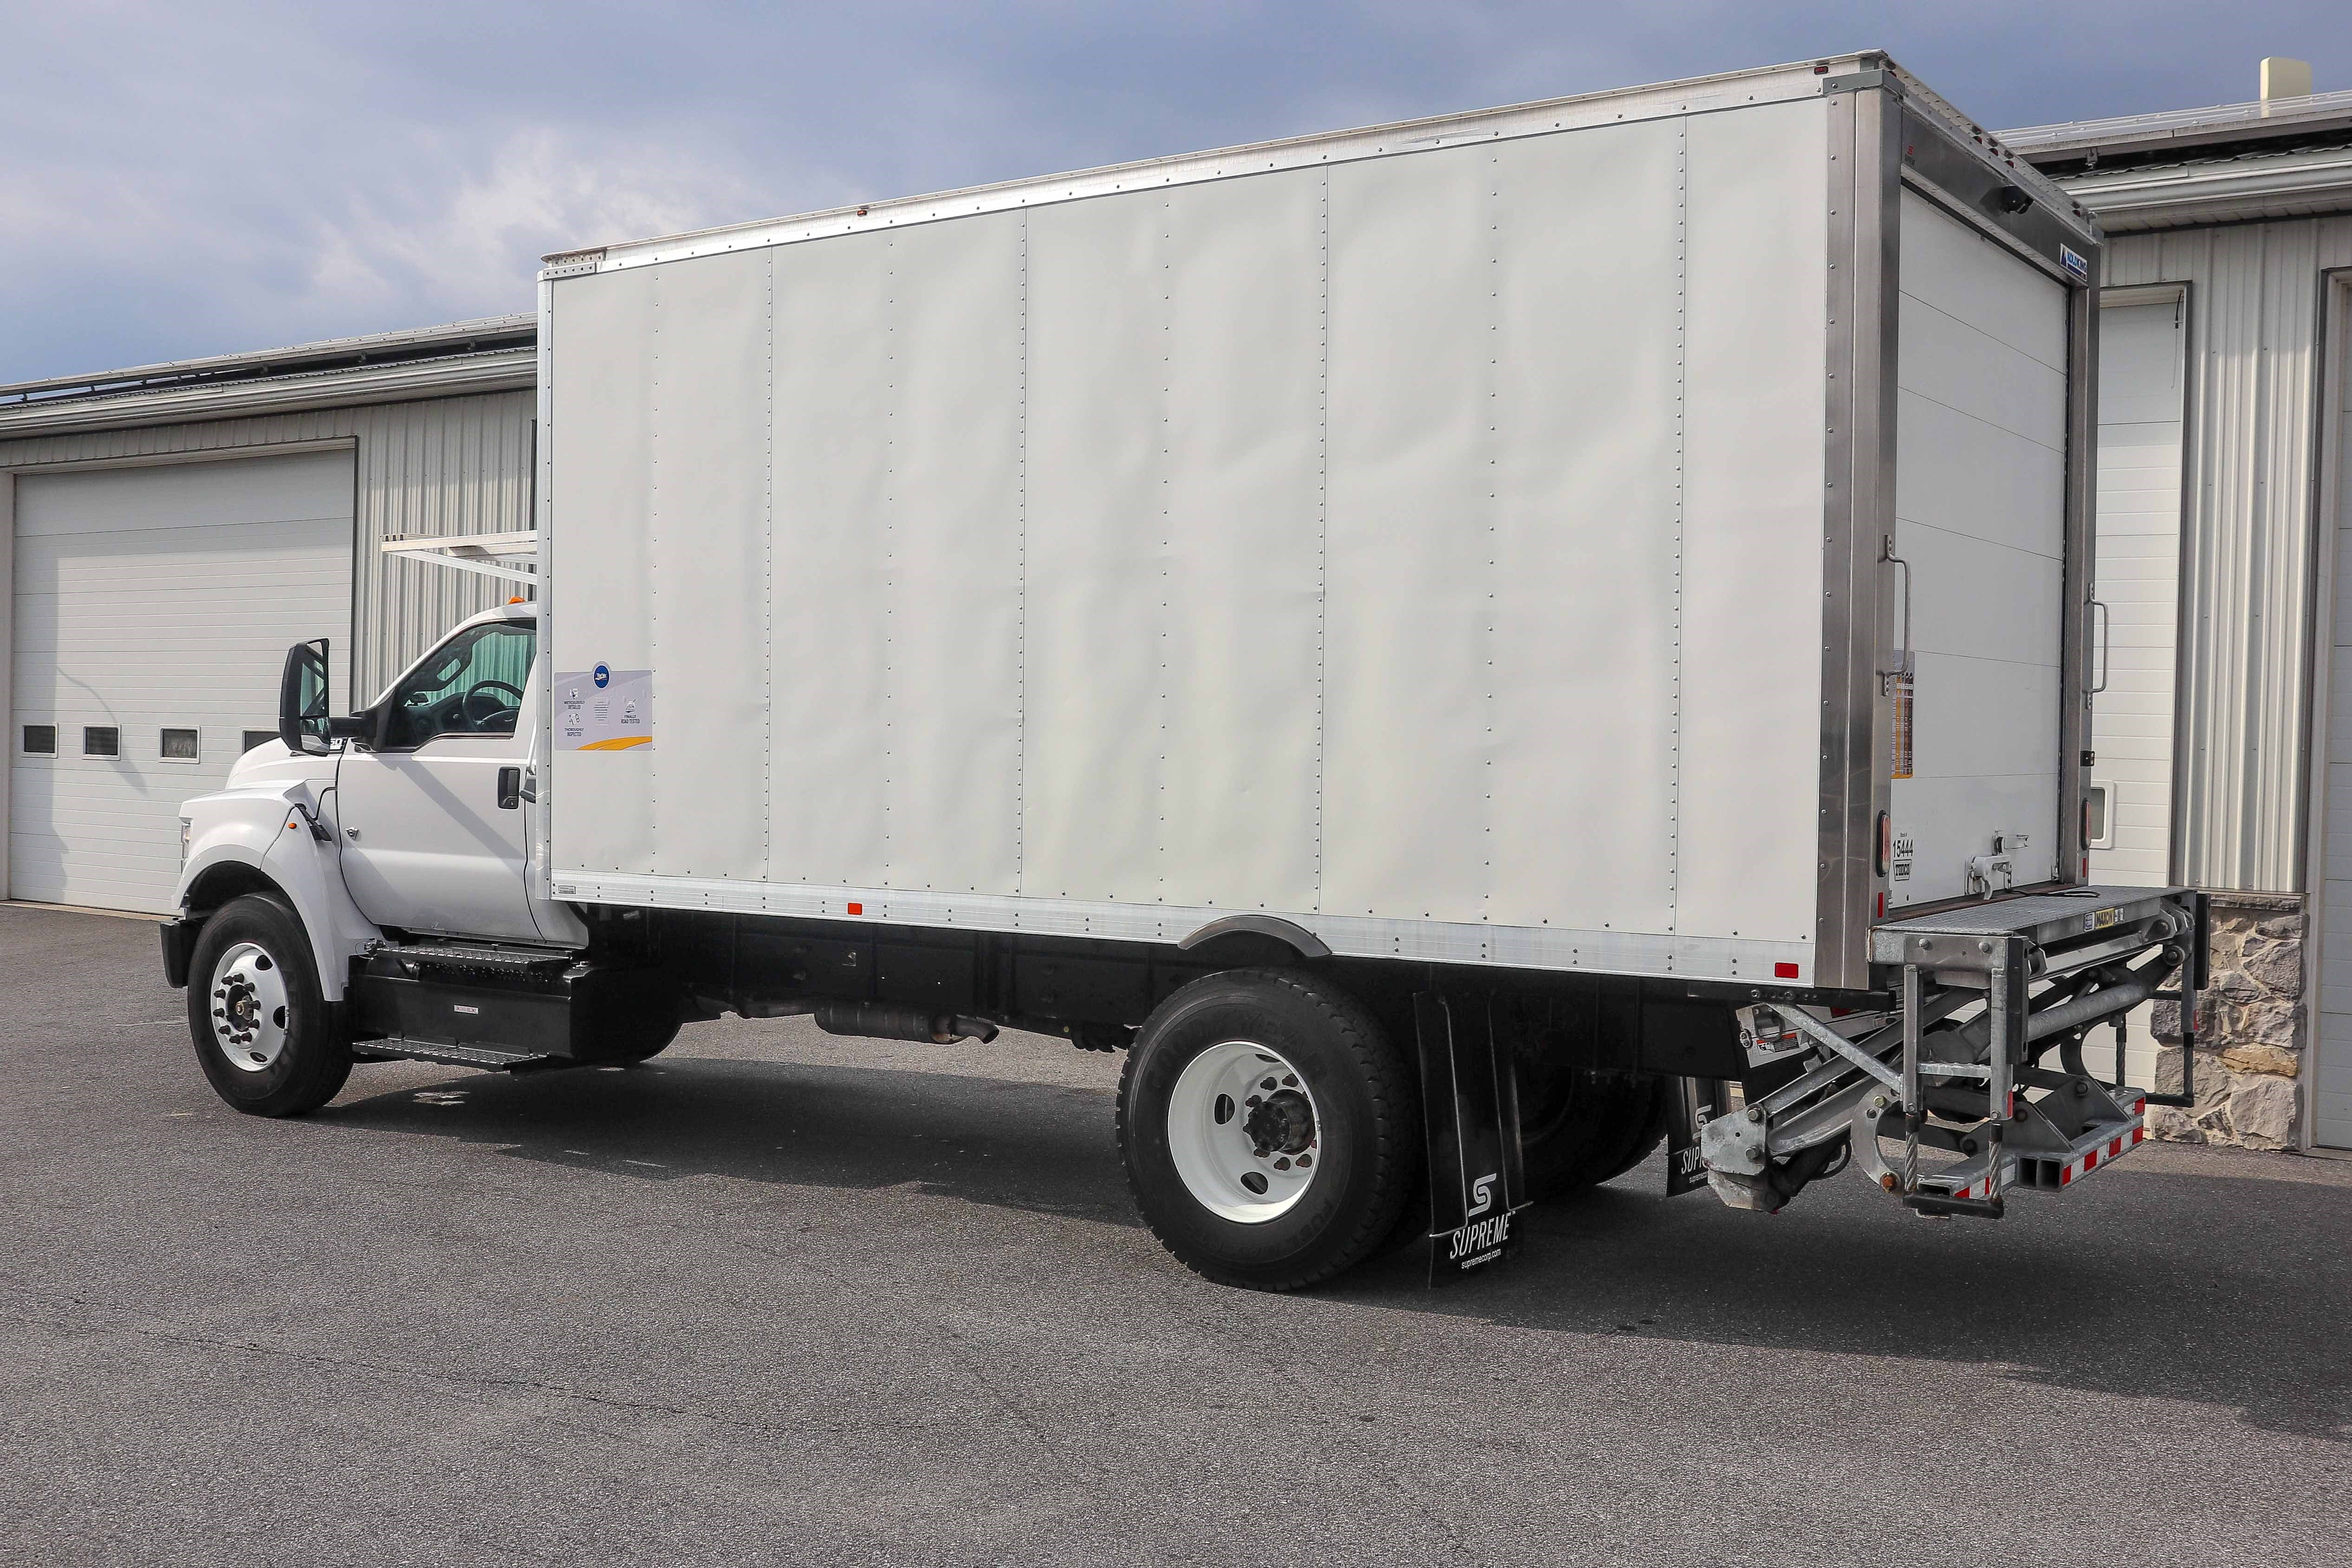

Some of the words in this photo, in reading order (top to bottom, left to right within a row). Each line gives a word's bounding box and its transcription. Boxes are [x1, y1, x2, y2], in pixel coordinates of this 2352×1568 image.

[1893, 839, 1913, 858] 15444
[2096, 911, 2113, 928] MAXON
[1450, 1212, 1511, 1259] SUPREME
[1461, 1249, 1501, 1269] supremecorp.com
